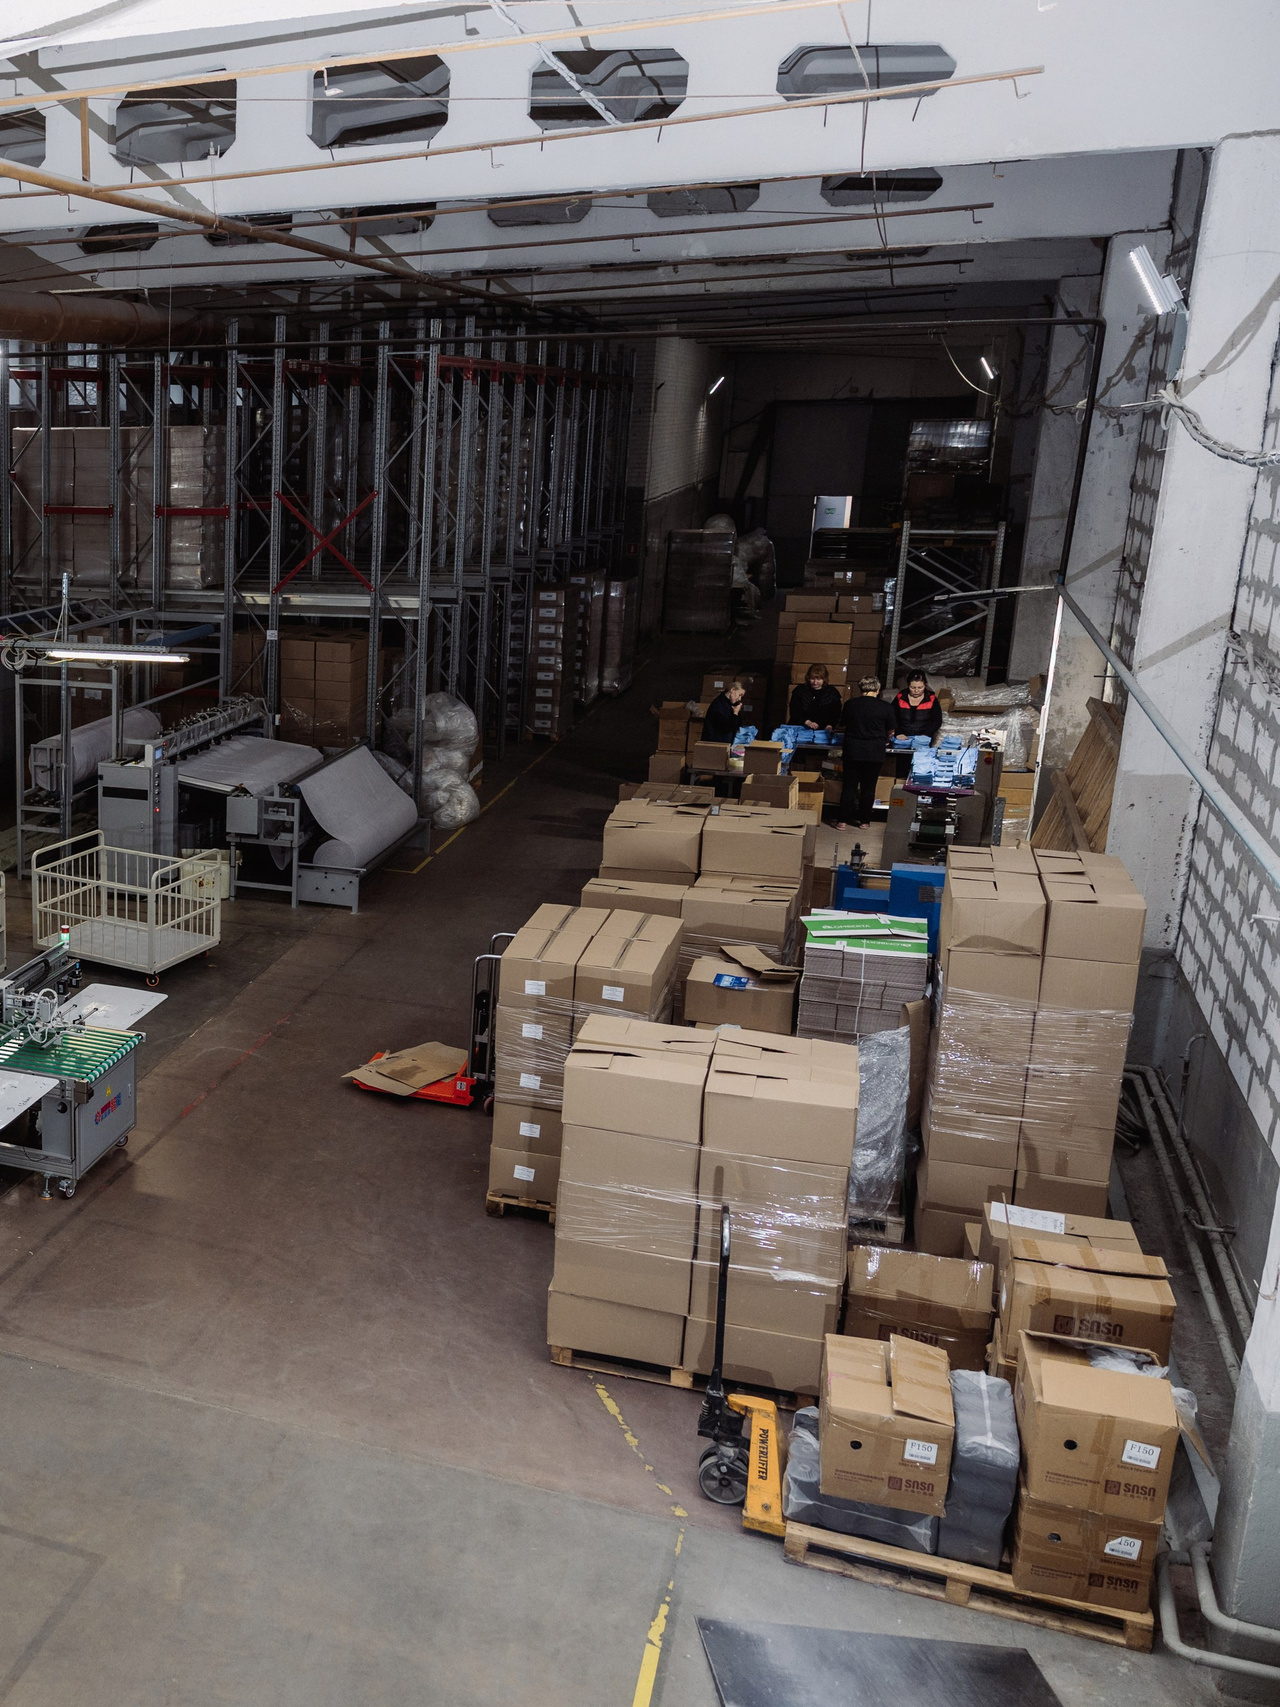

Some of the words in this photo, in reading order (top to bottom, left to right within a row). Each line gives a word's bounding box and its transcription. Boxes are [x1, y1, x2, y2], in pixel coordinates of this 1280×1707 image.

[757, 1427, 769, 1480] POWERLIFTER
[910, 1442, 933, 1453] F150
[1130, 1443, 1155, 1456] F150
